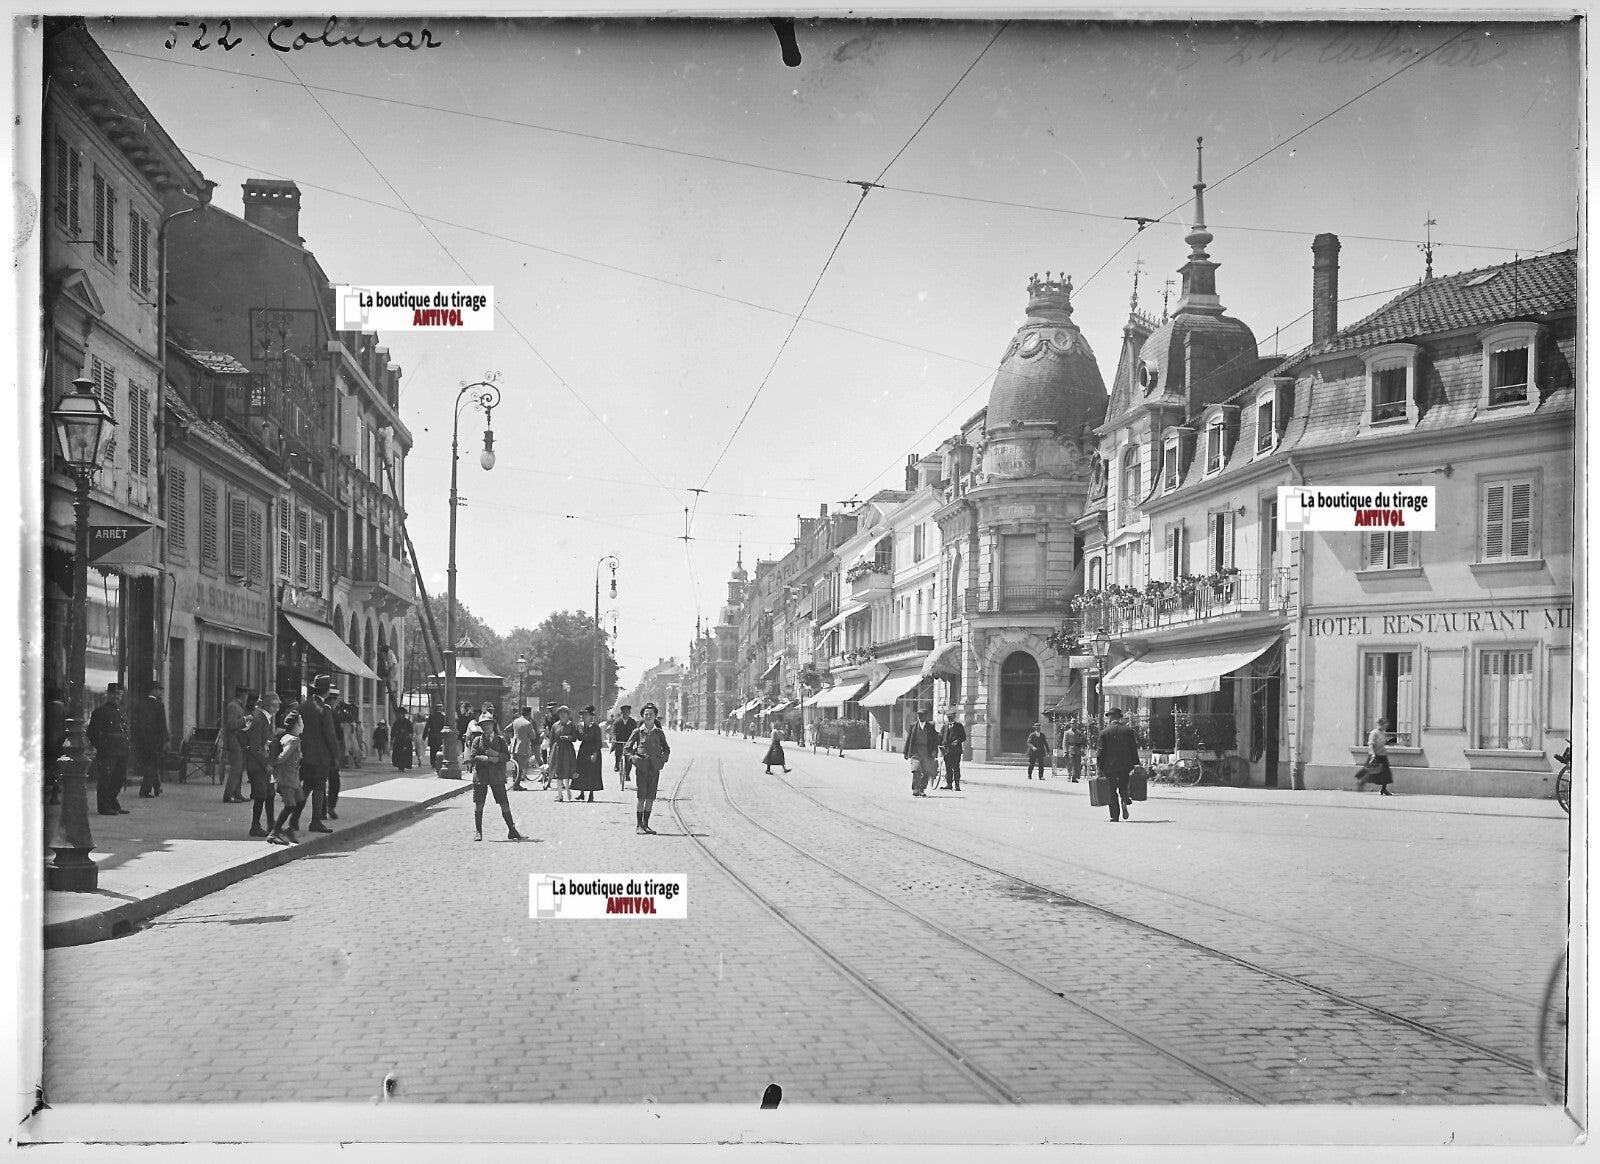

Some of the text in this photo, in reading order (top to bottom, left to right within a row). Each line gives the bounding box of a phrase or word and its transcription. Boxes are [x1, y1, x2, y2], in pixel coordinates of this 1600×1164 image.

[268, 15, 442, 52] Colmar
[95, 527, 128, 539] ARRÊT
[1308, 616, 1372, 637] HOTEL
[1382, 608, 1529, 635] RESTAURANT
